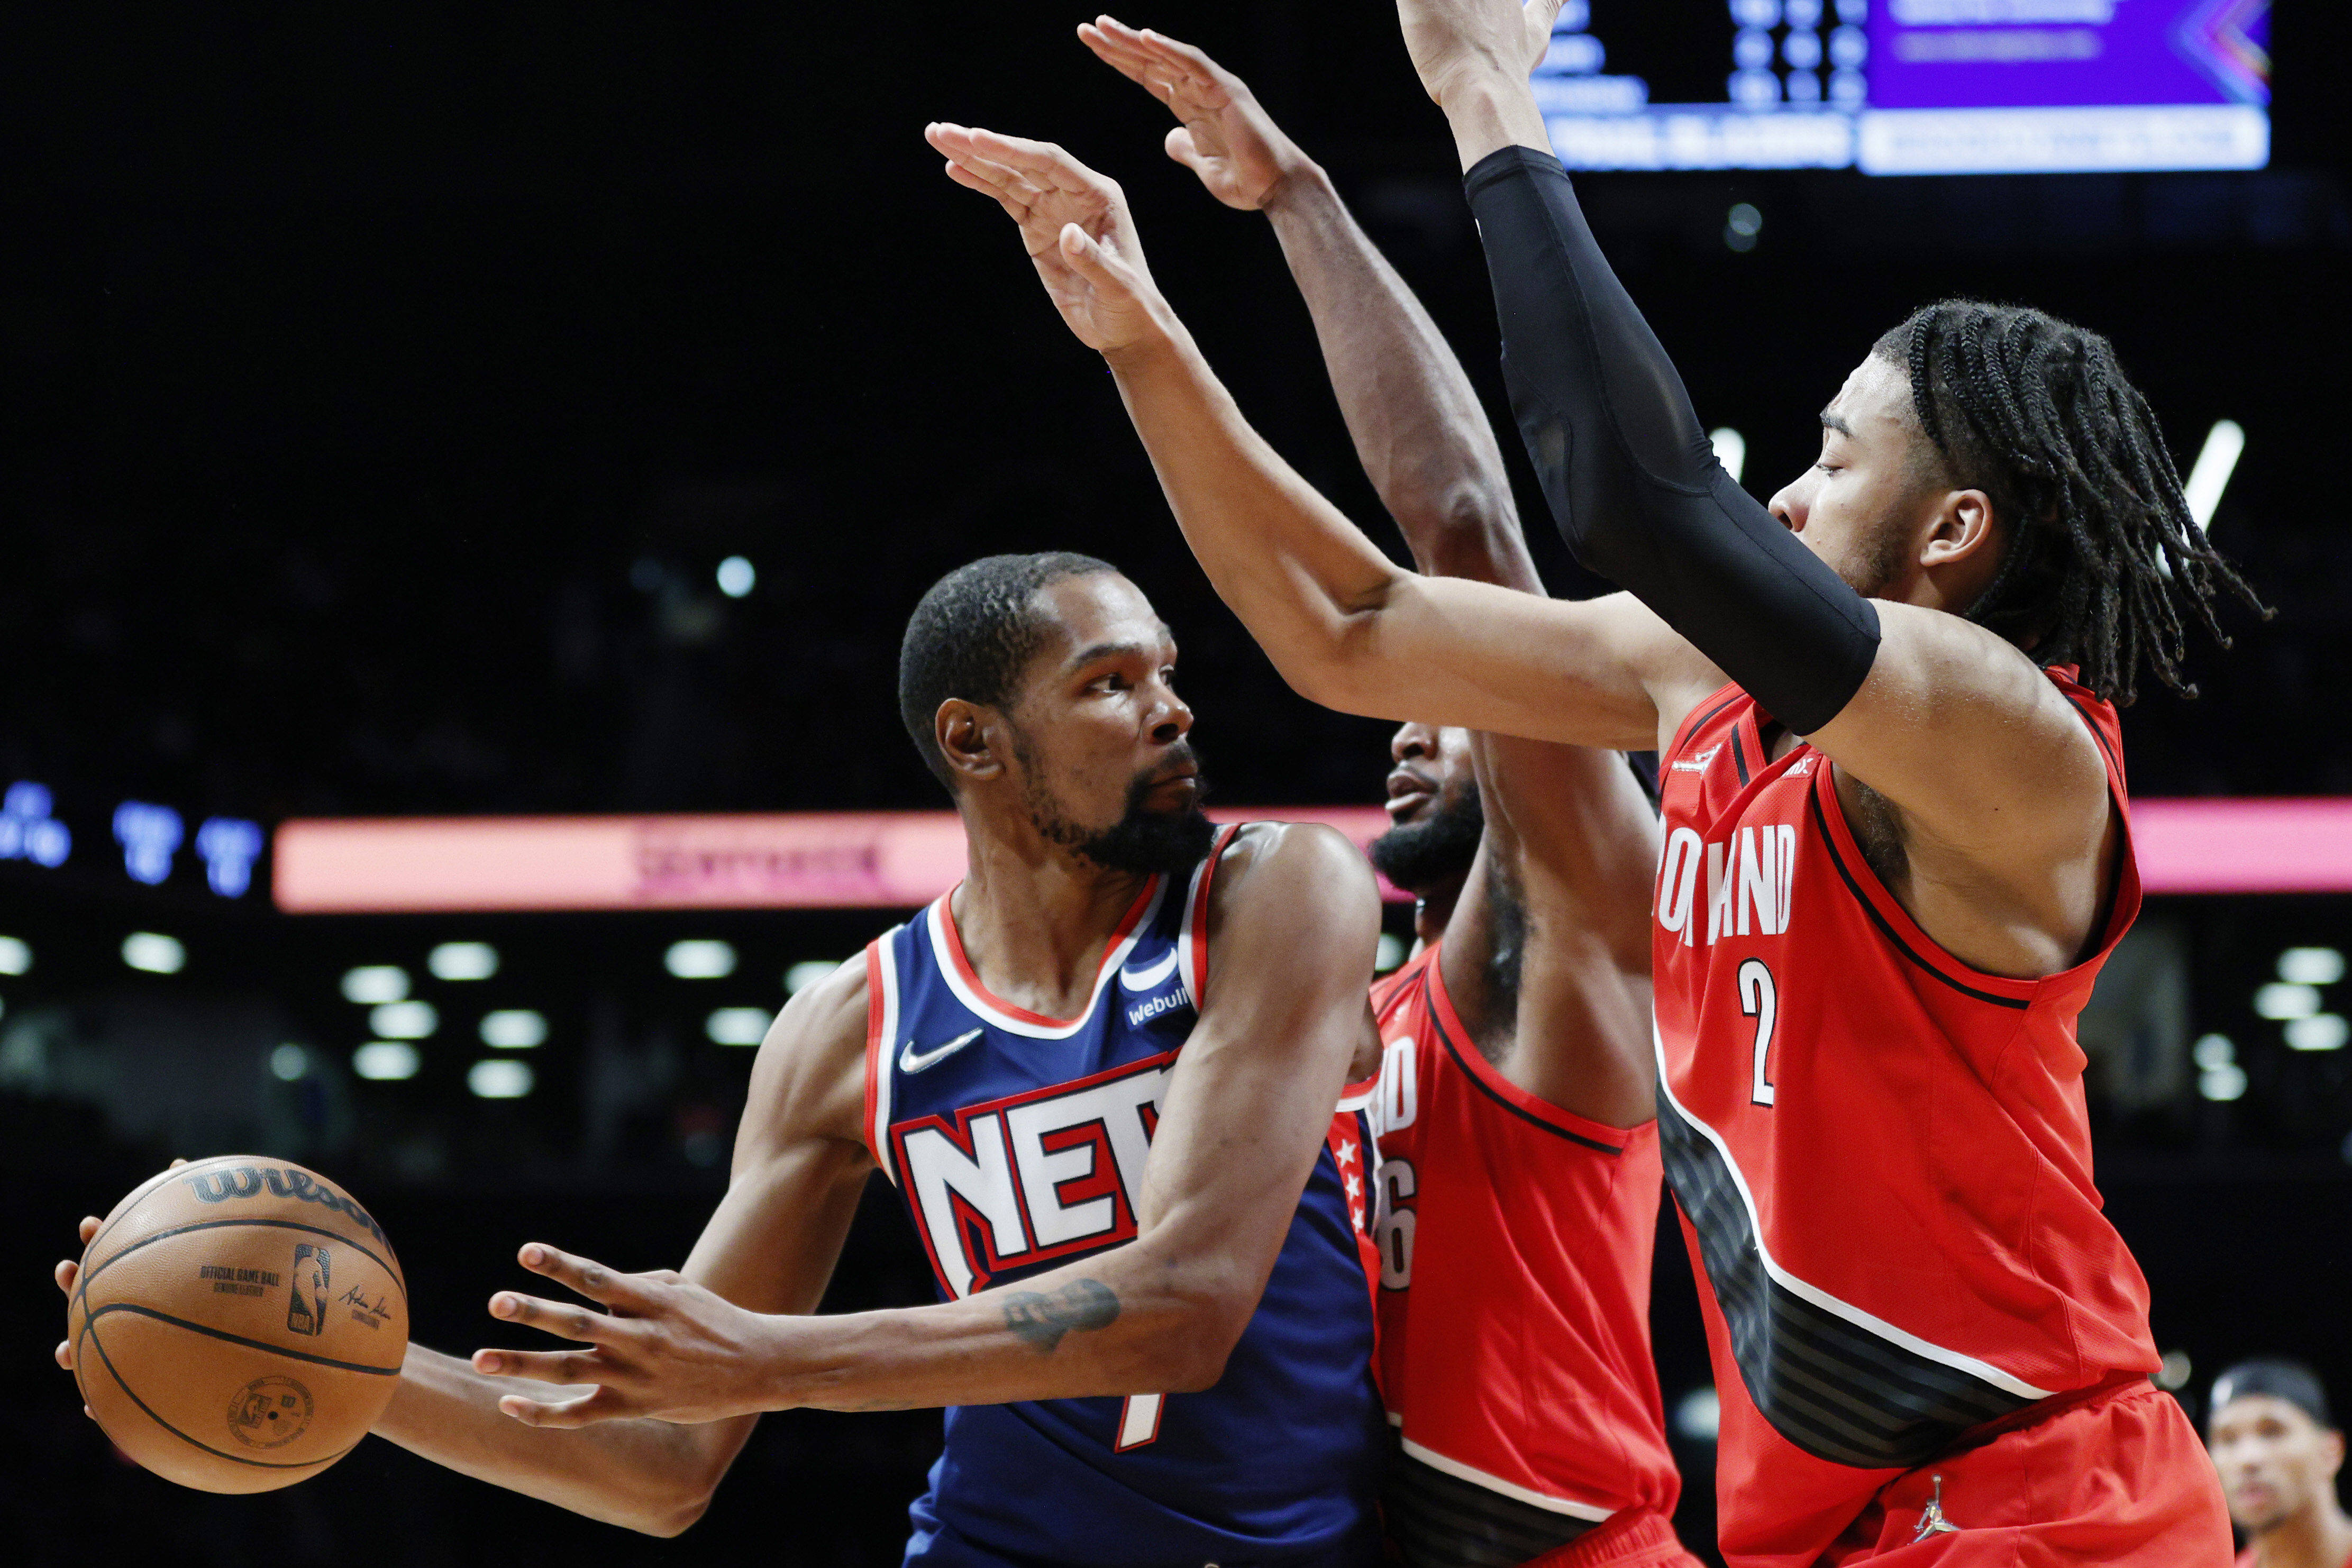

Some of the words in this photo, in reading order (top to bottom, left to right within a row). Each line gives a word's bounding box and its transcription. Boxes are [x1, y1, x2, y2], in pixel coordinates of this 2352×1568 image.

[1128, 987, 1188, 1026] Webull
[1738, 957, 1776, 1108] 2
[891, 1044, 1183, 1301] NET
[237, 1269, 259, 1283] GAME
[261, 1271, 279, 1287] BALL
